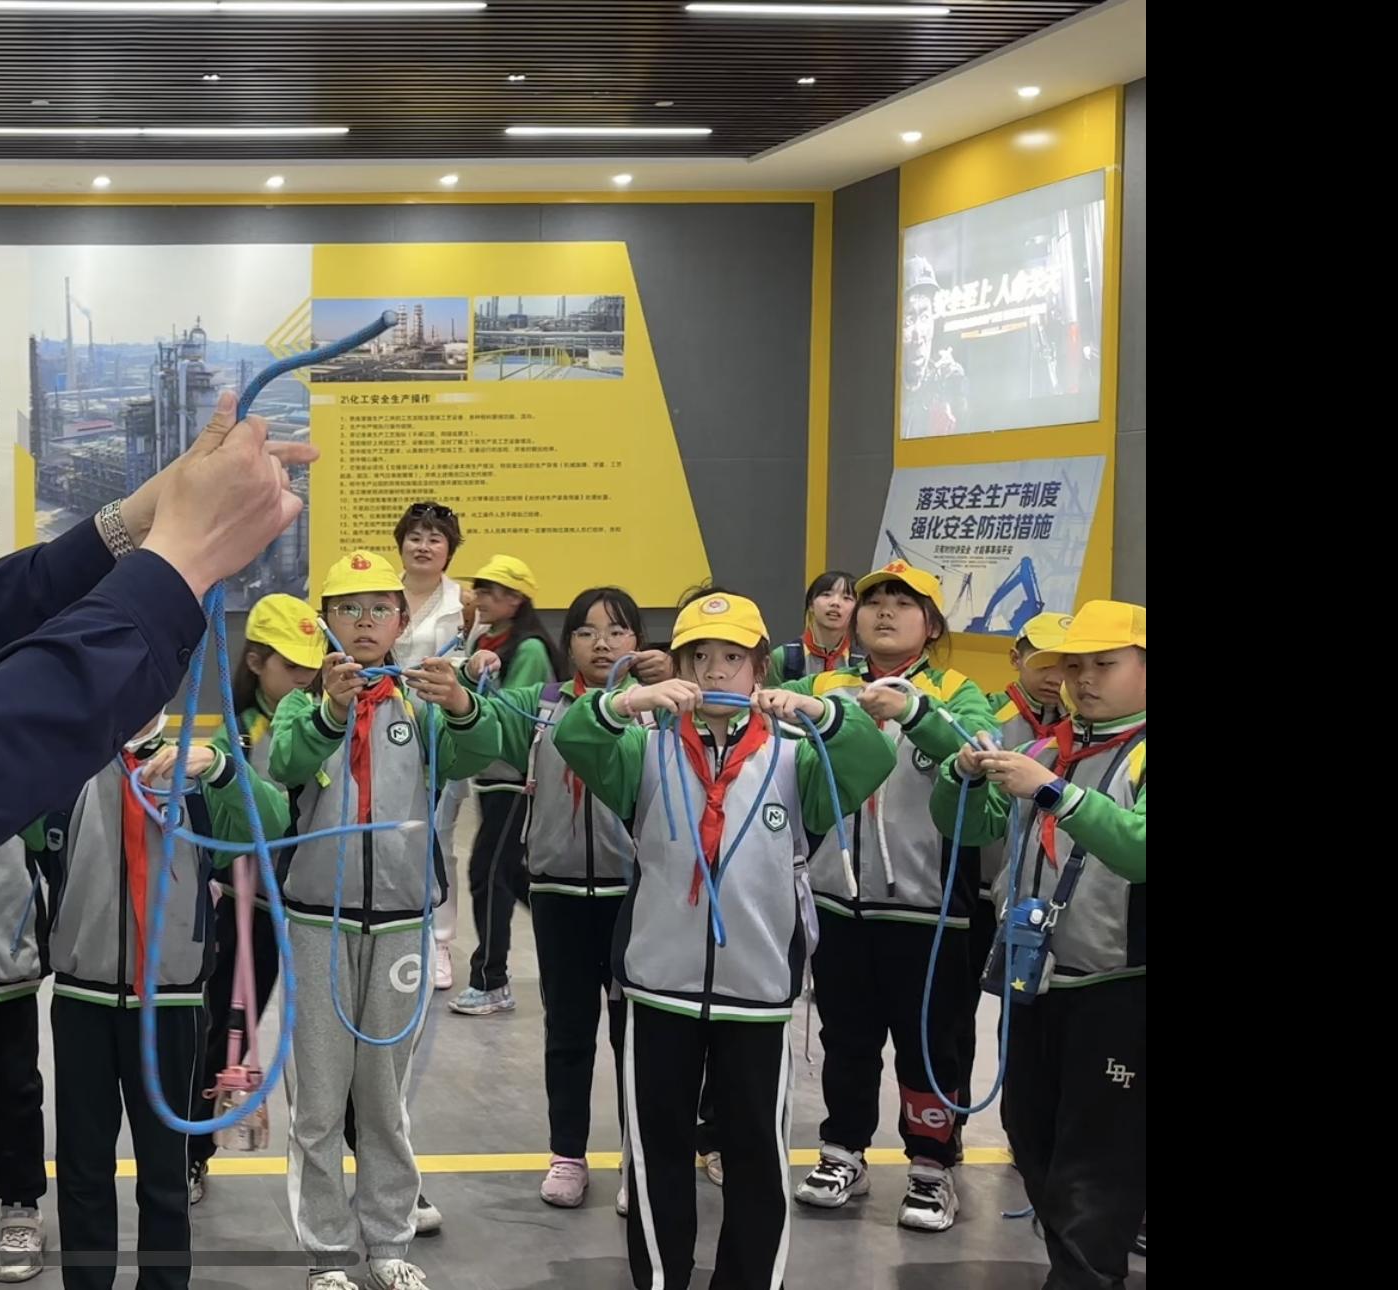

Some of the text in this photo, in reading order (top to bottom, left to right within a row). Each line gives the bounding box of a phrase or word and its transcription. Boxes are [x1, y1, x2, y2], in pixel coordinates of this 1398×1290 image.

[916, 481, 1061, 511] 落实安全生产制度
[910, 513, 1054, 540] 强化安全防范措施
[389, 953, 423, 993] G
[1104, 1057, 1136, 1090] LBT
